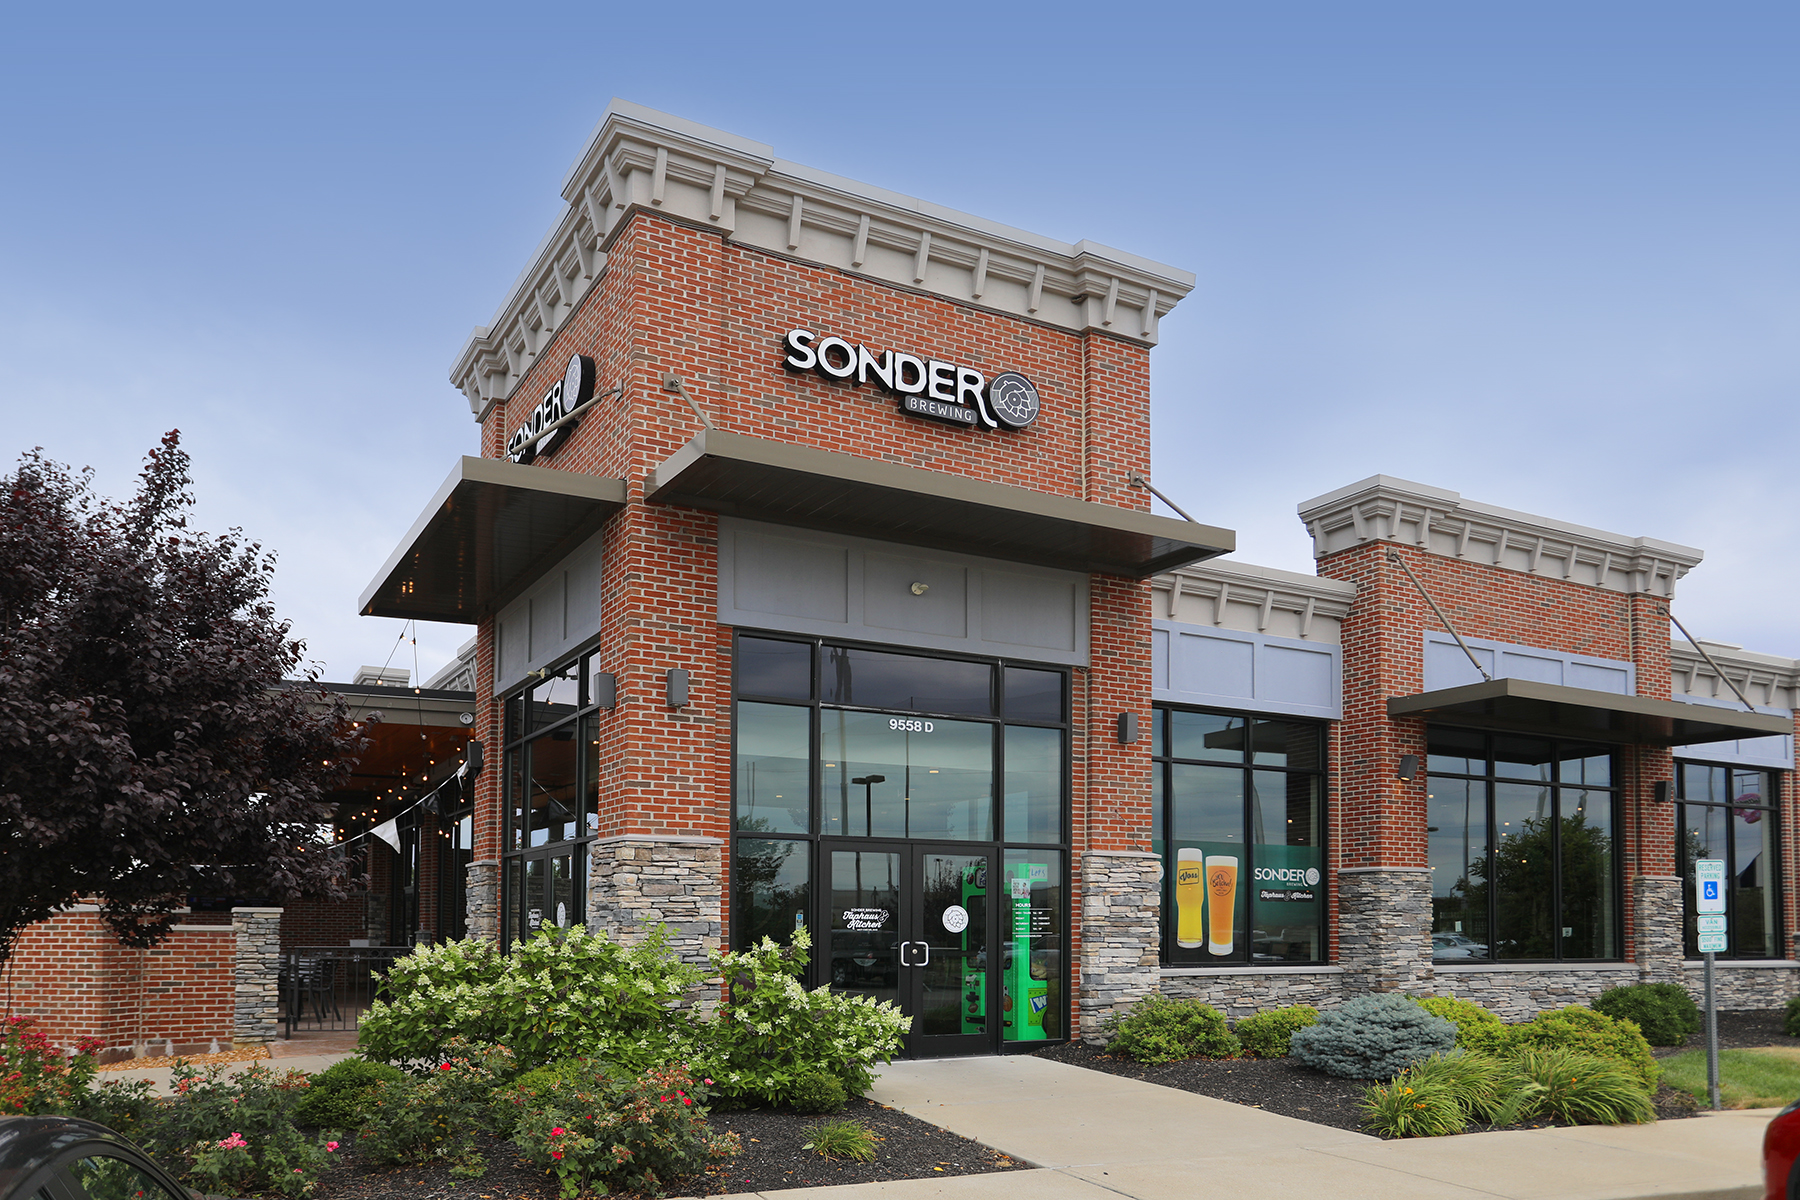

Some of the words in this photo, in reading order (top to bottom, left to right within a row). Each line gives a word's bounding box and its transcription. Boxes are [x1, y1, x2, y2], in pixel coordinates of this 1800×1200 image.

[787, 328, 998, 427] SONDER
[910, 397, 973, 421] BREWING
[889, 718, 922, 732] 9558
[924, 721, 934, 733] D
[1254, 867, 1308, 887] SONDER
[1698, 864, 1722, 872] RESERVED
